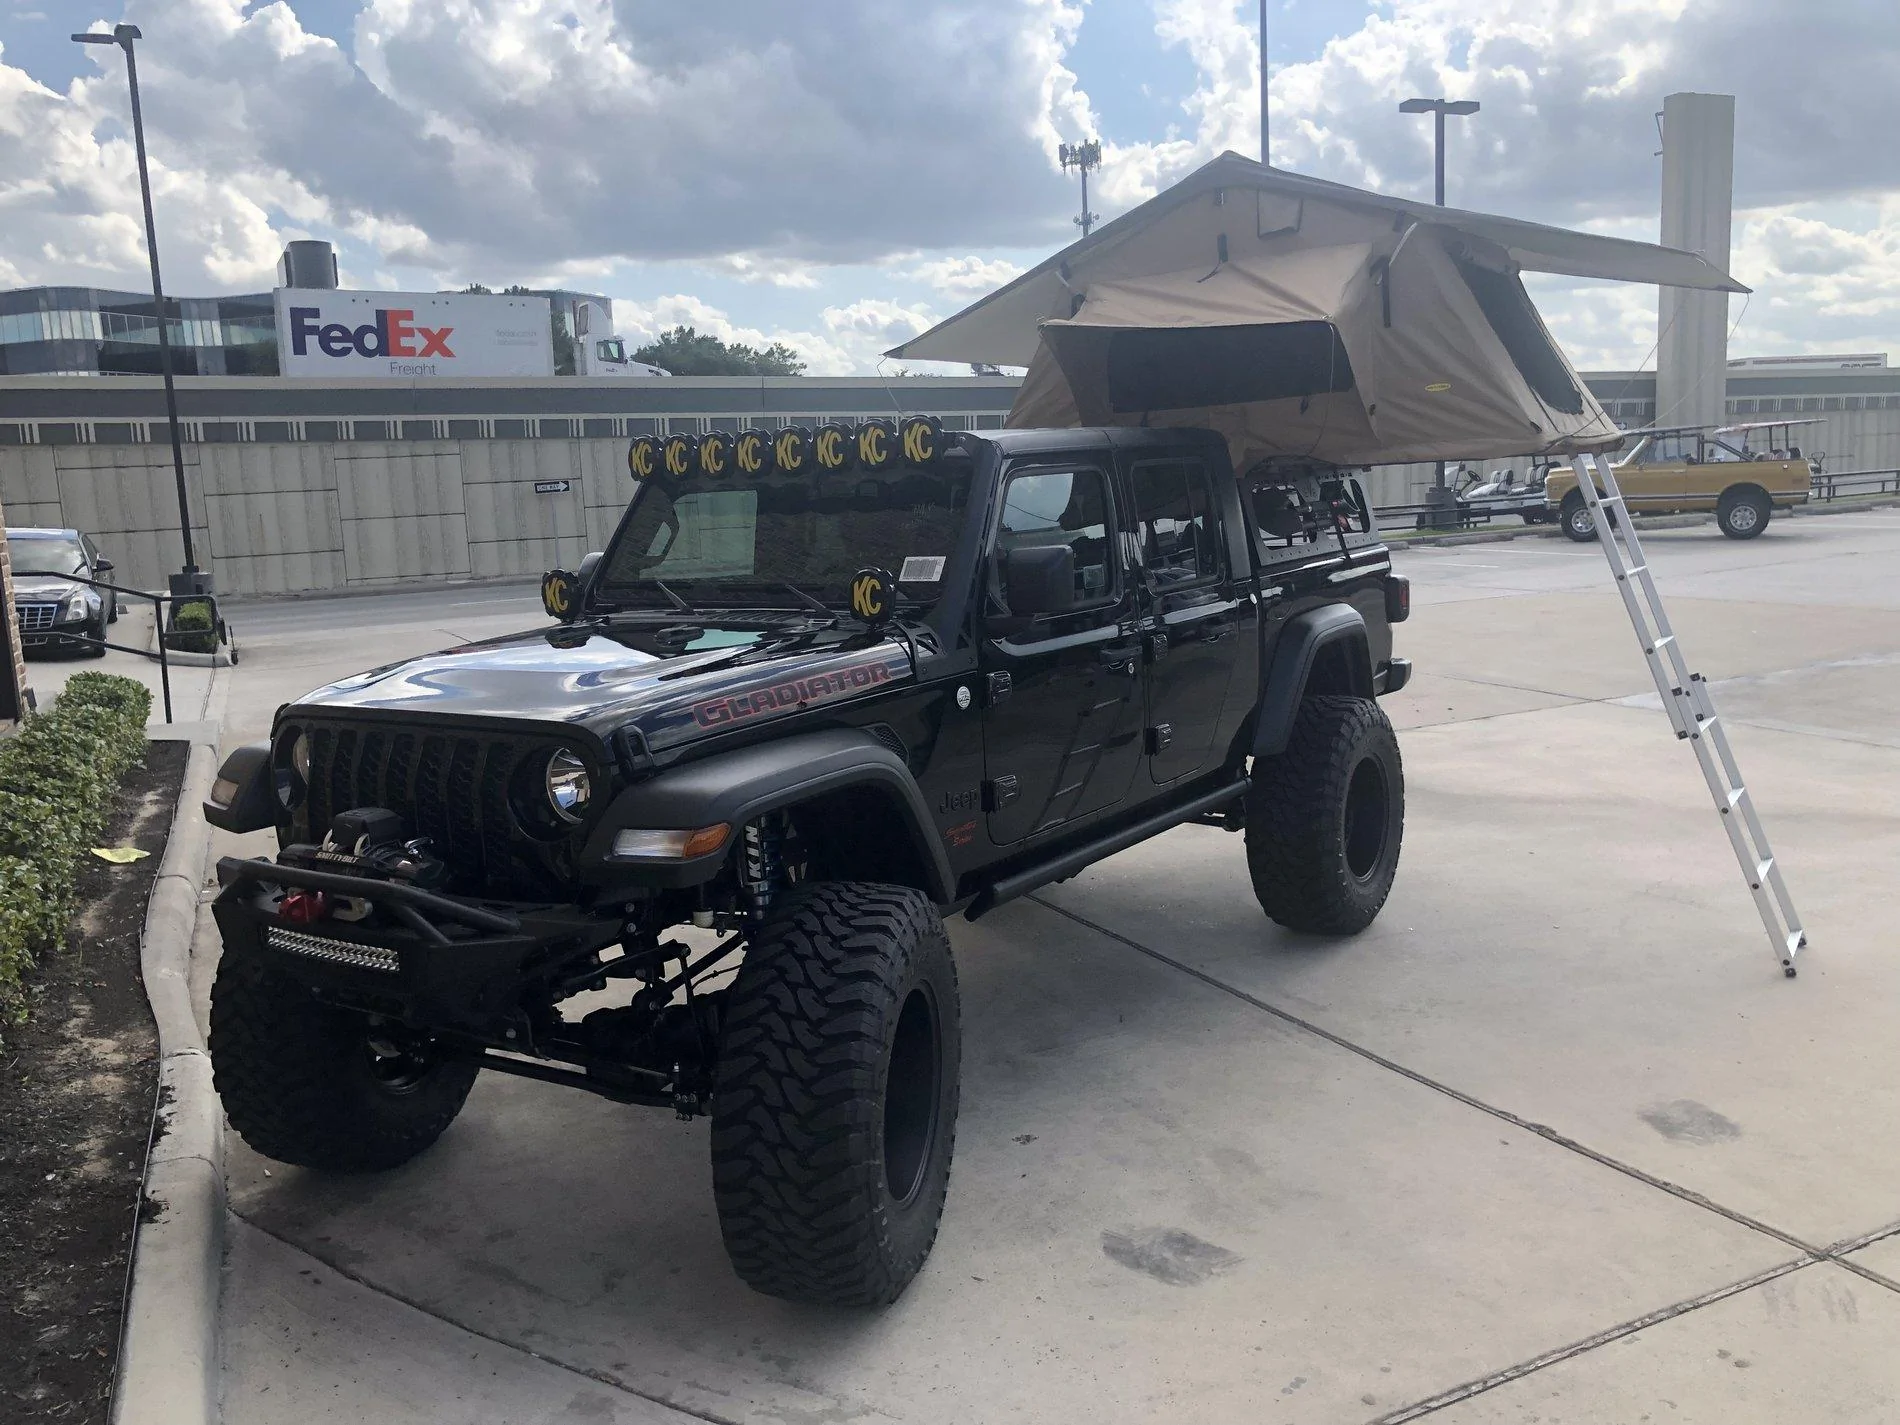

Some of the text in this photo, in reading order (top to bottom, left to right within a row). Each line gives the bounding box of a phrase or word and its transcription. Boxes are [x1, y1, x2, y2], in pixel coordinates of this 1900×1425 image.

[289, 307, 457, 358] FedEx
[390, 361, 437, 376] Freight
[632, 441, 653, 476] KC
[665, 441, 688, 475] KC
[701, 438, 724, 475] KC
[738, 435, 762, 472] KC
[776, 433, 801, 470] KC
[816, 430, 843, 468] KC
[859, 427, 886, 465] KC
[904, 423, 933, 462] KC
[545, 577, 568, 613] KC
[854, 576, 882, 616] KC
[693, 662, 892, 728] GLADIATOR
